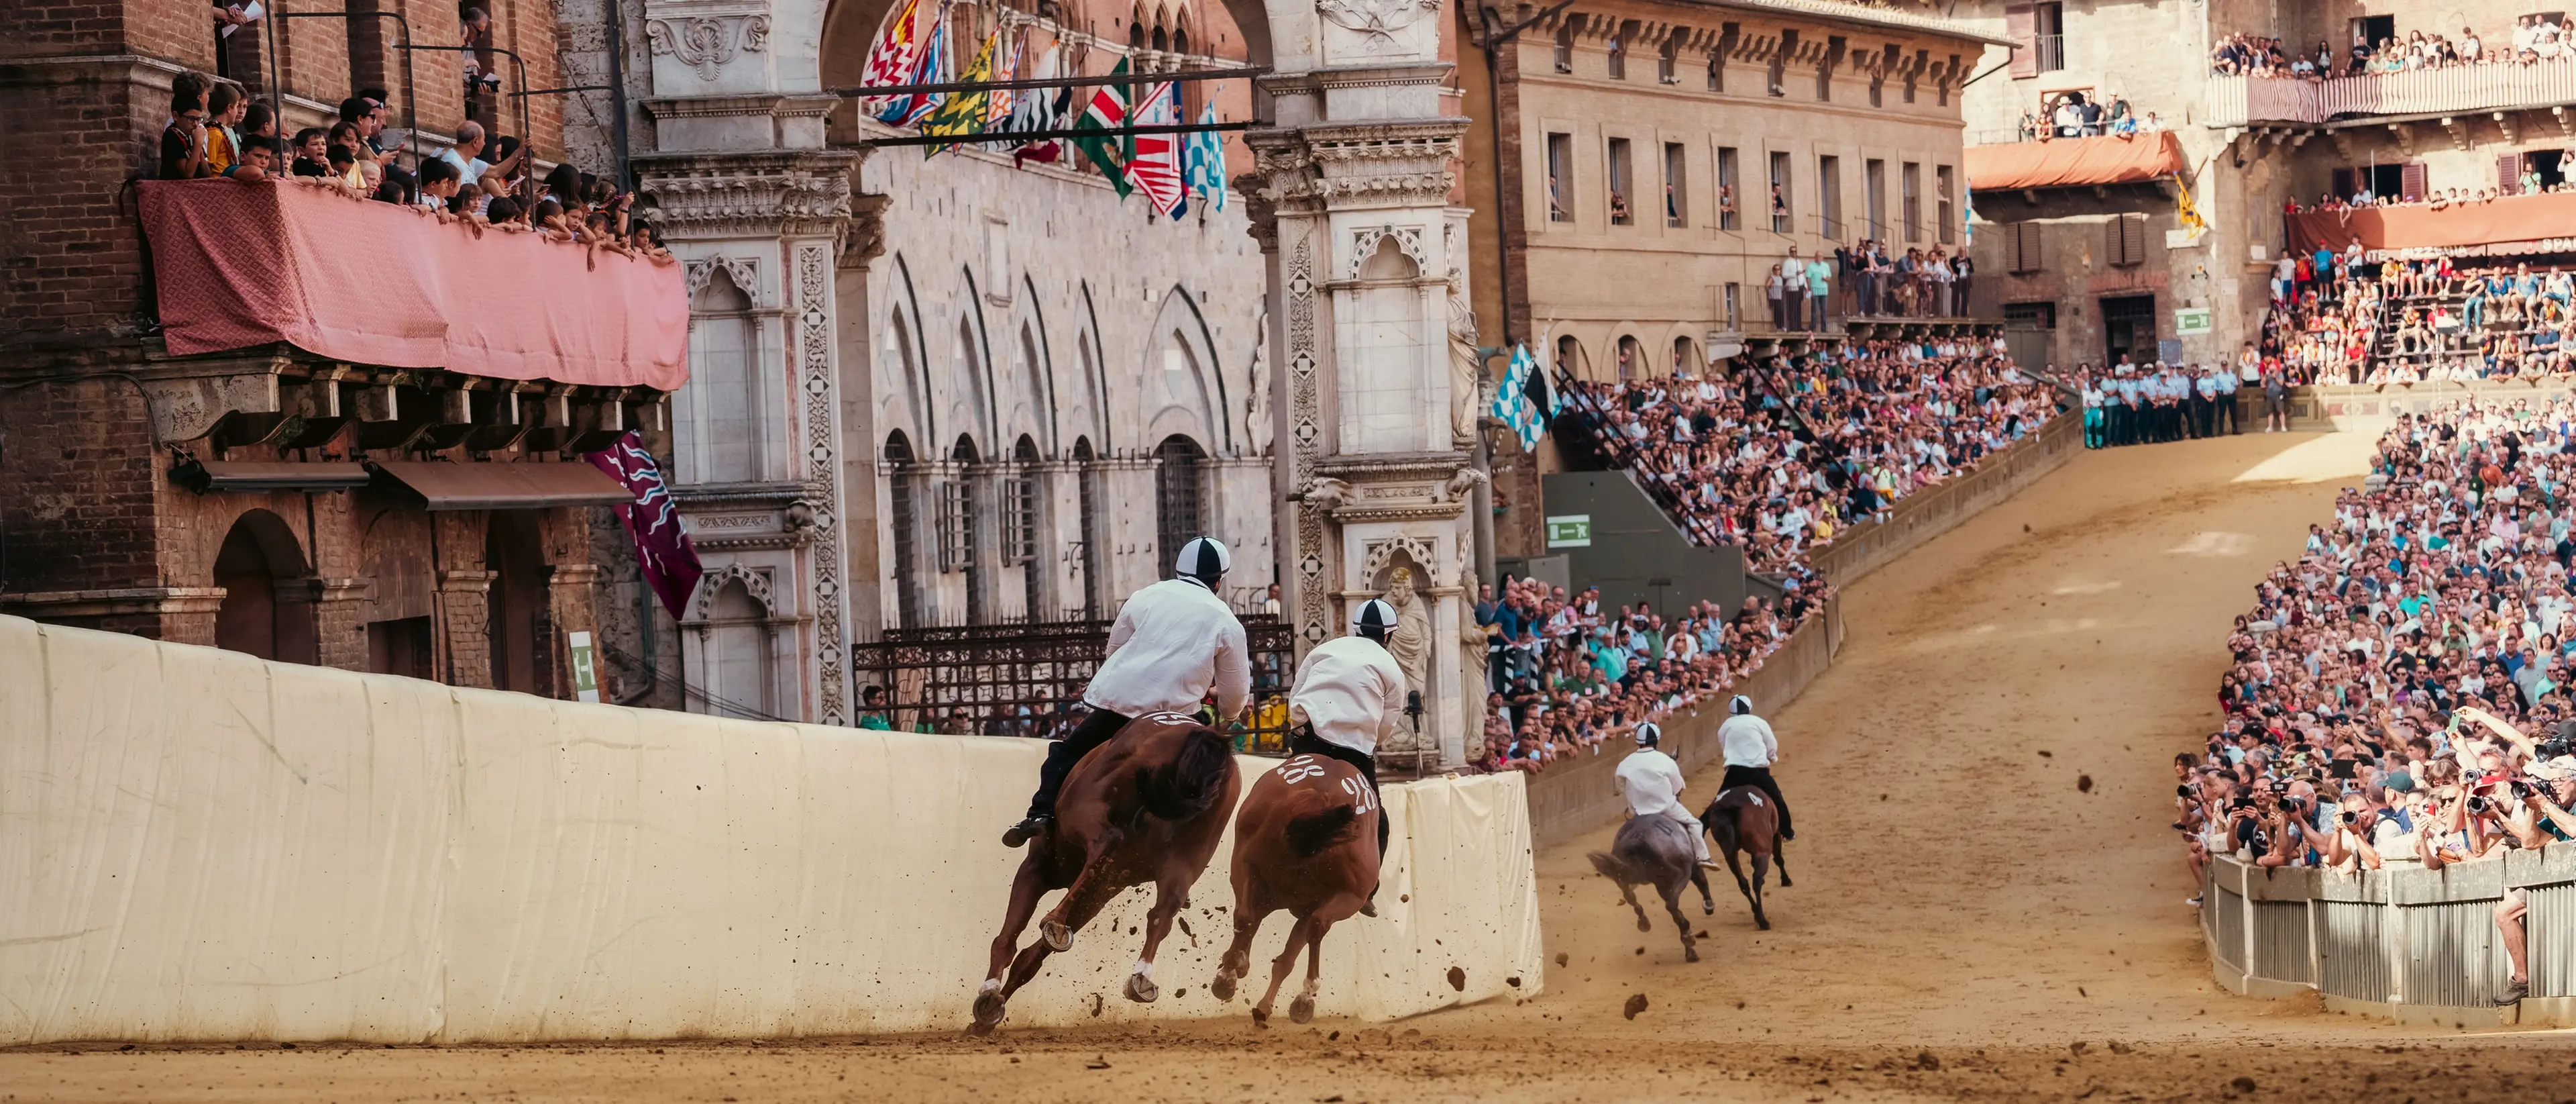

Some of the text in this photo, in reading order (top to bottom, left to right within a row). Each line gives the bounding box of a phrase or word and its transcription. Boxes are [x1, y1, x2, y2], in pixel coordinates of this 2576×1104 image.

[1277, 755, 1325, 784] 28
[1341, 773, 1375, 815] 28
[1748, 792, 1763, 807] 4
